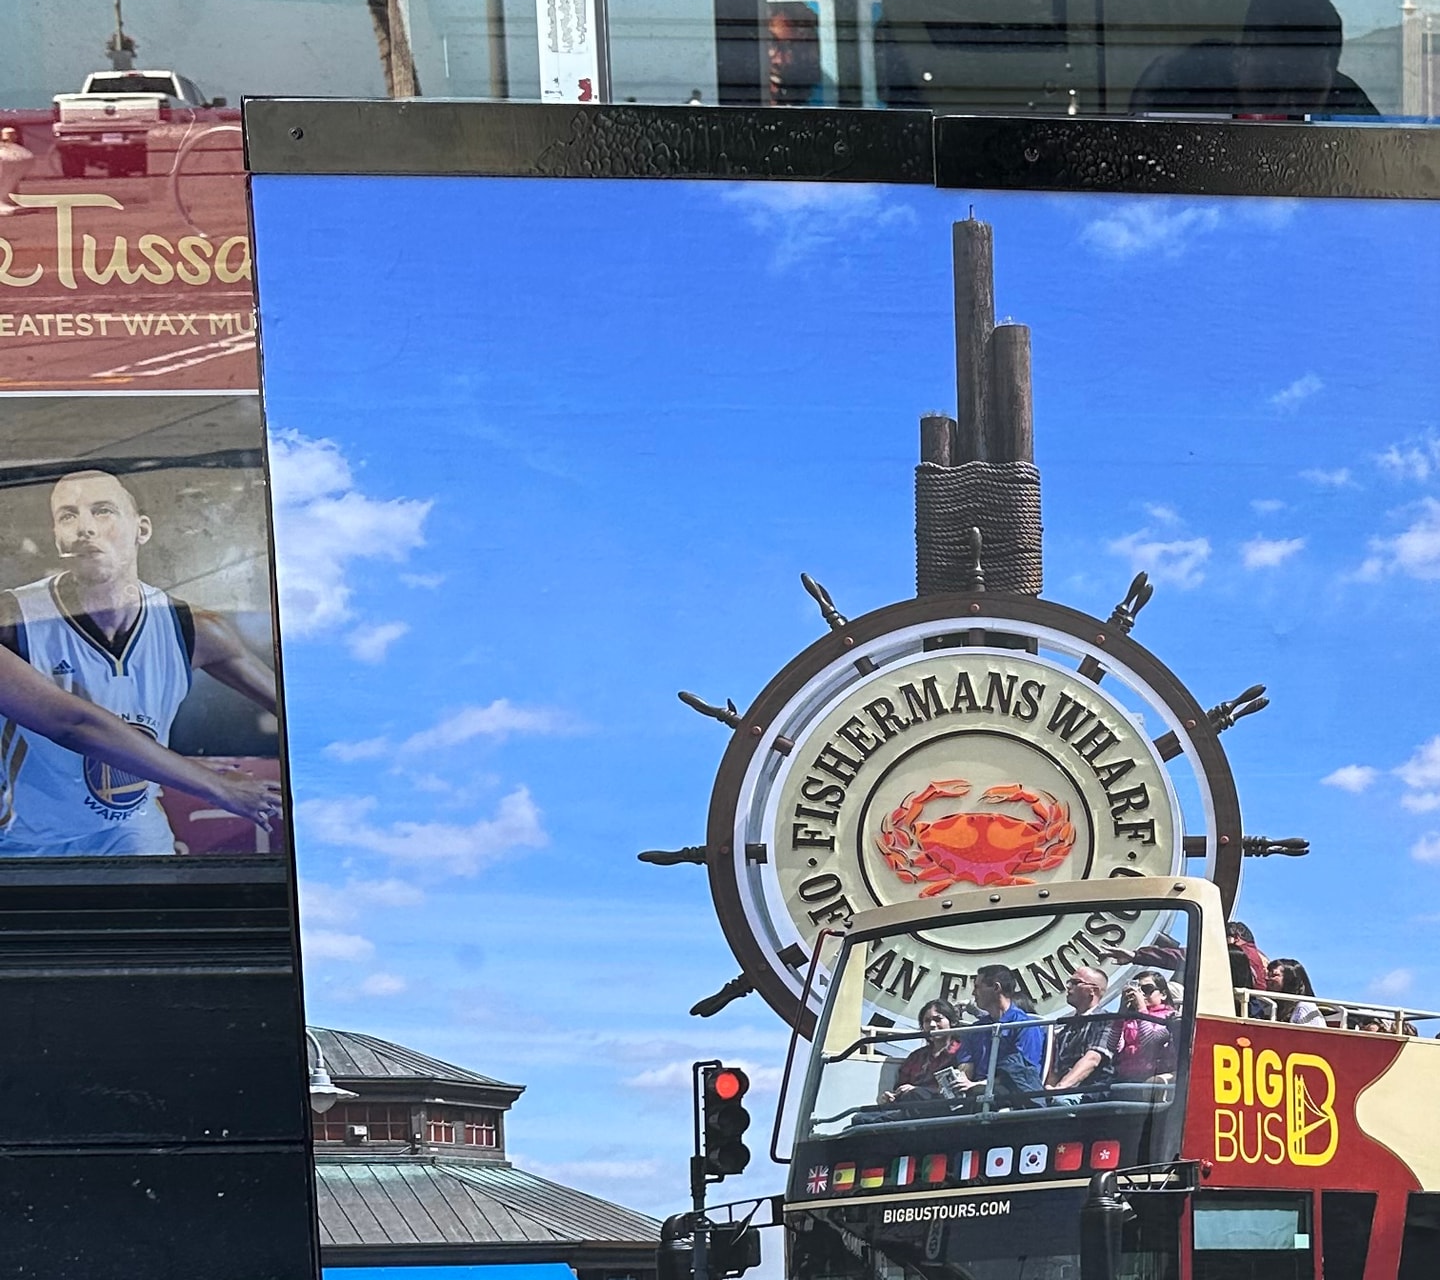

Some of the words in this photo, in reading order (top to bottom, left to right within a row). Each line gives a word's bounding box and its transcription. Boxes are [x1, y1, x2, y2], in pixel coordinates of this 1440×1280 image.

[8, 192, 252, 290] Tussa
[0, 313, 109, 336] EATEST
[121, 313, 199, 336] WAX
[792, 671, 1047, 852] FISHERMANS
[1046, 690, 1160, 848] WHARF
[798, 872, 855, 927] OF
[864, 933, 929, 1004] AN
[1213, 1043, 1284, 1108] BIG
[1214, 1108, 1286, 1165] BUS
[883, 1200, 1011, 1224] BIGBUSTOURS.COM
